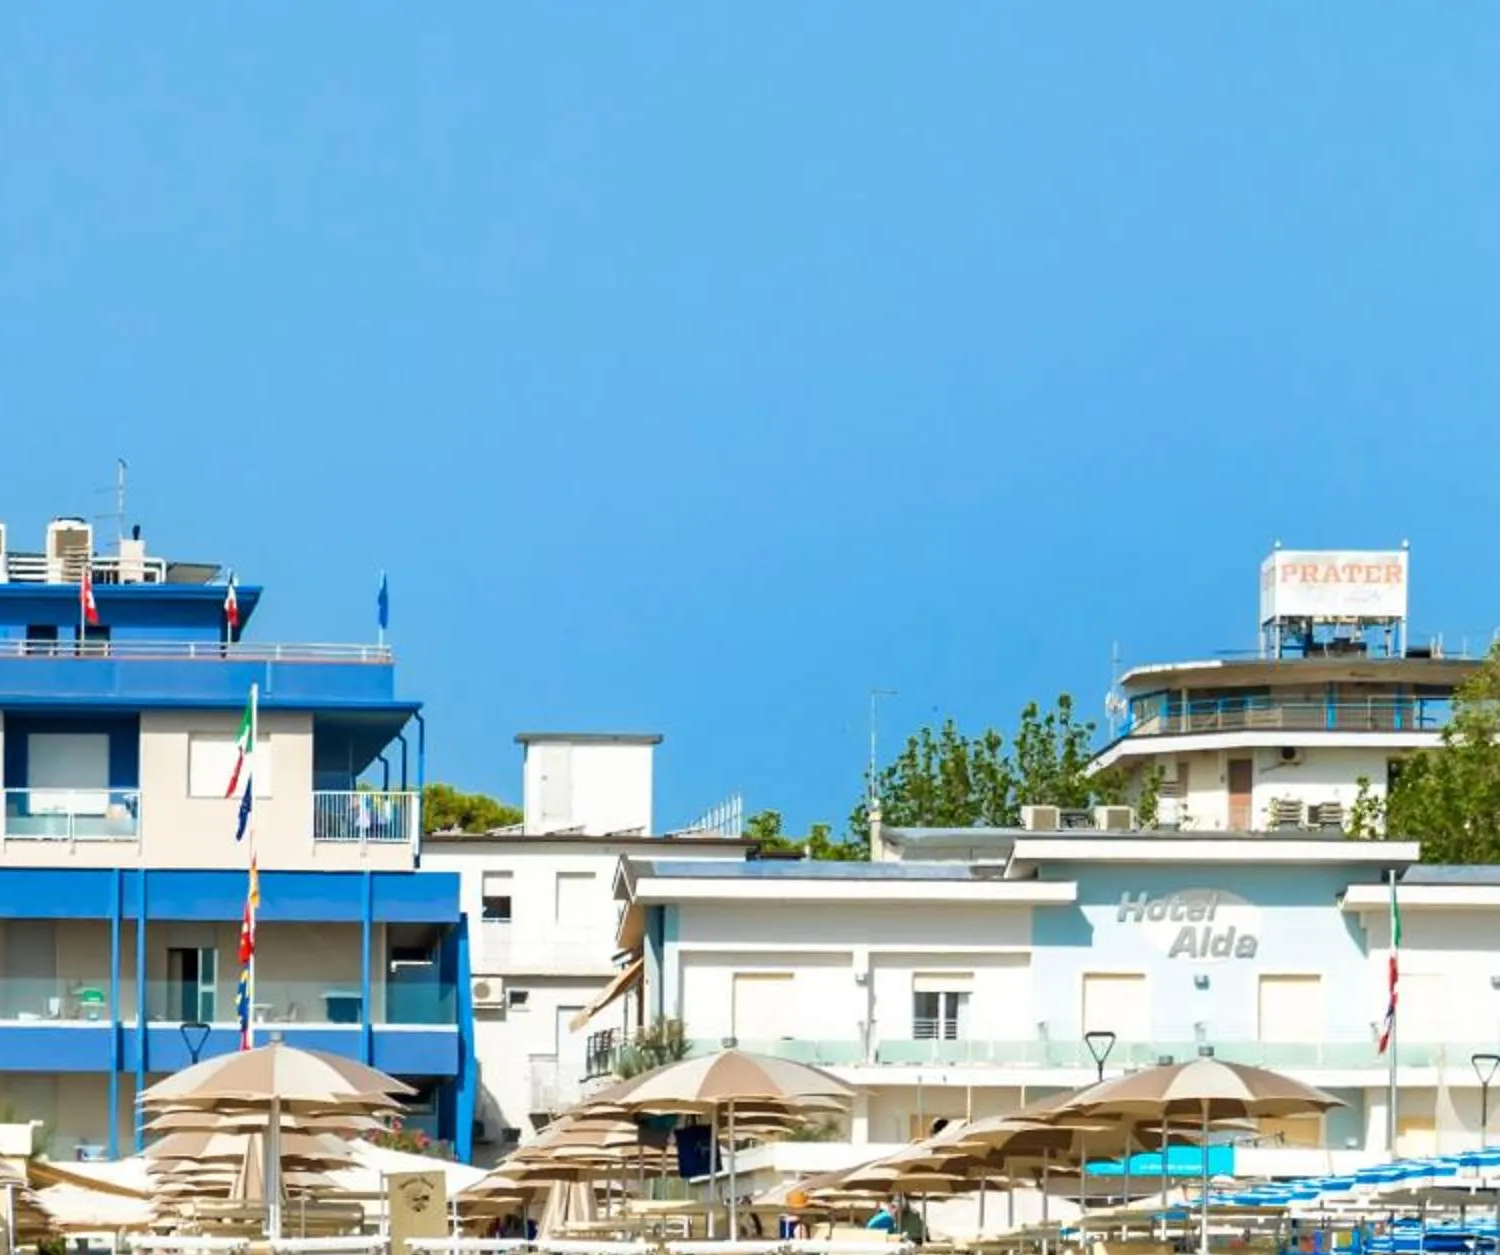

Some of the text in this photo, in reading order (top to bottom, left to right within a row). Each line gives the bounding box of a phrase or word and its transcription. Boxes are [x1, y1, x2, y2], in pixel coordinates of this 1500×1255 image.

[1281, 563, 1404, 584] PRATER
[1116, 891, 1221, 923] Hotel
[1167, 925, 1258, 959] Alda
